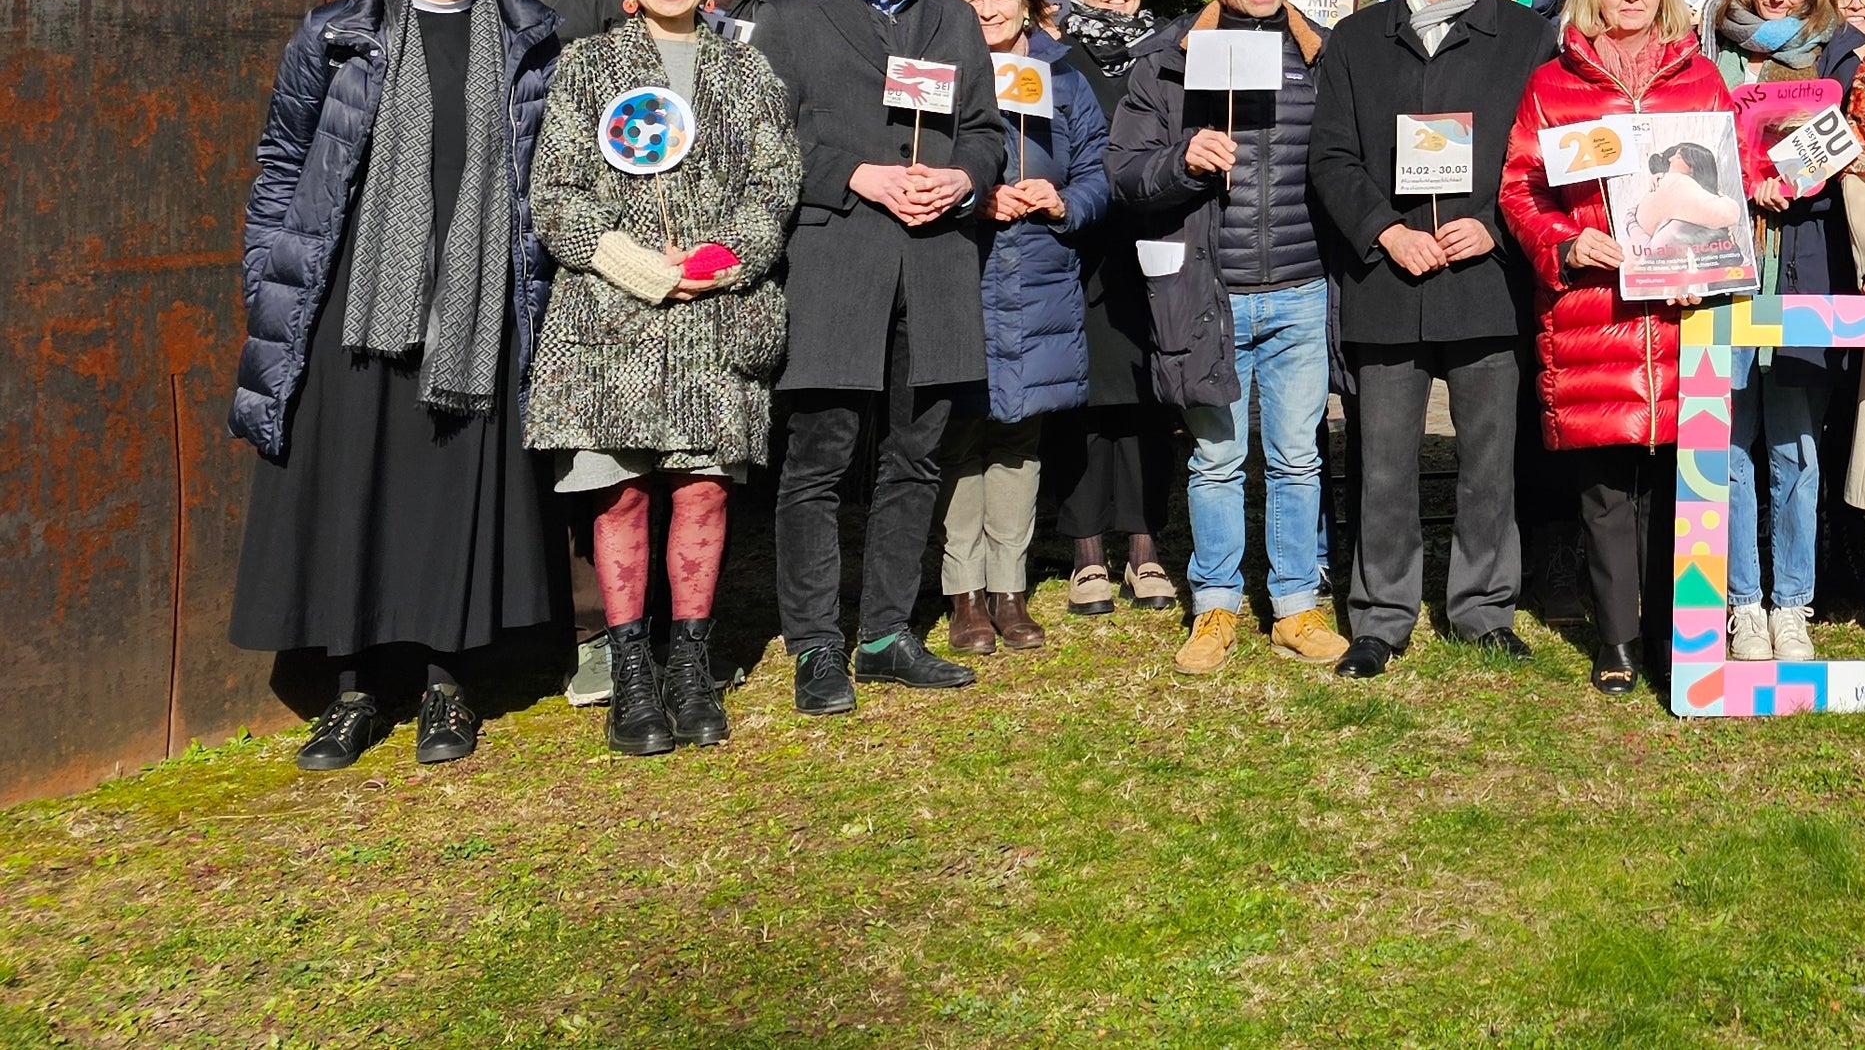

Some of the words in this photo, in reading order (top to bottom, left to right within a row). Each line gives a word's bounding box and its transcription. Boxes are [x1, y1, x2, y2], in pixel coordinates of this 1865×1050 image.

[997, 63, 1043, 104] 20
[1777, 84, 1824, 102] wichtig
[1413, 128, 1448, 152] 20
[1813, 110, 1853, 157] DU
[1559, 126, 1622, 174] 20
[1791, 136, 1817, 174] WICHTIG
[1807, 141, 1829, 168] MIR
[1401, 166, 1429, 175] 14.02
[1439, 165, 1468, 174] 30.03
[1632, 244, 1652, 257] Un
